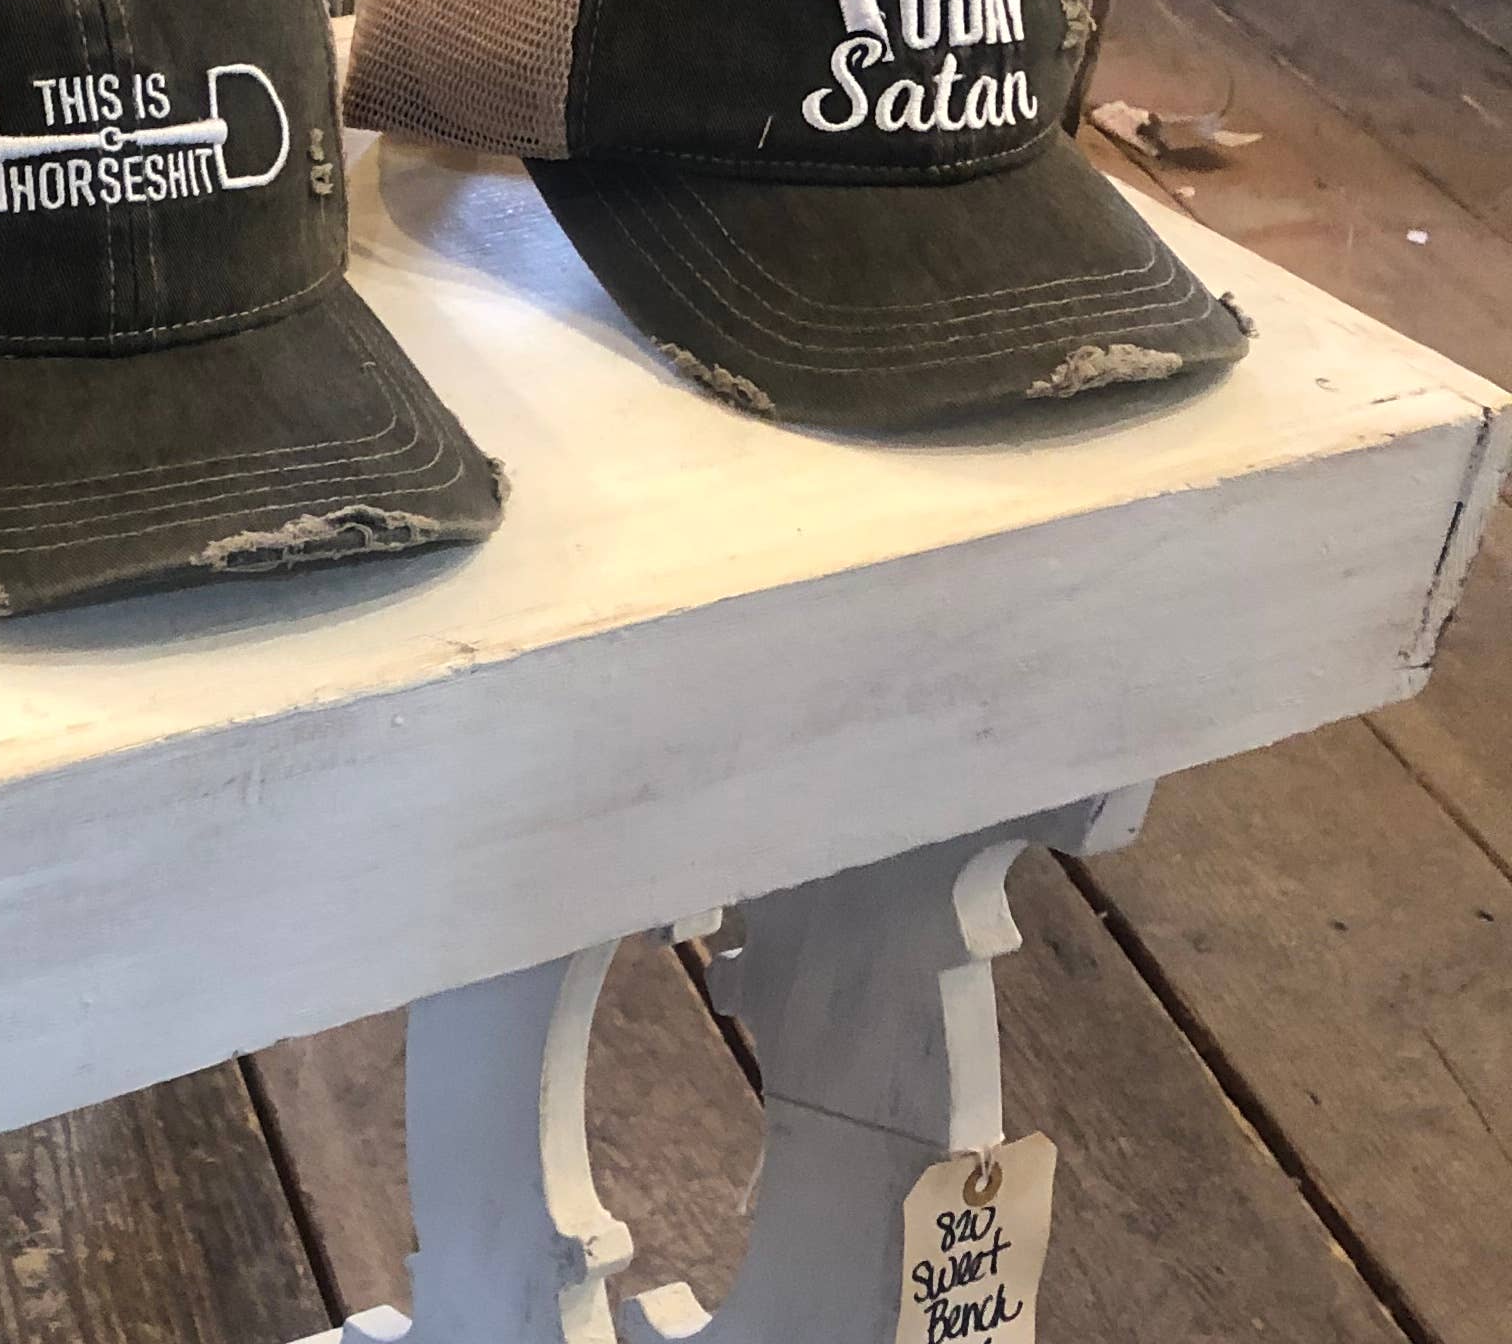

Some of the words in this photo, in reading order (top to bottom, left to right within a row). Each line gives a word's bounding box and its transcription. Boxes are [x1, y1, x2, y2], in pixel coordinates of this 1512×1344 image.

[32, 73, 123, 127] THIS
[133, 72, 172, 121] IS
[801, 36, 1039, 133] Satan
[9, 147, 215, 214] HORSESHIT
[911, 1226, 1013, 1304] Sweet
